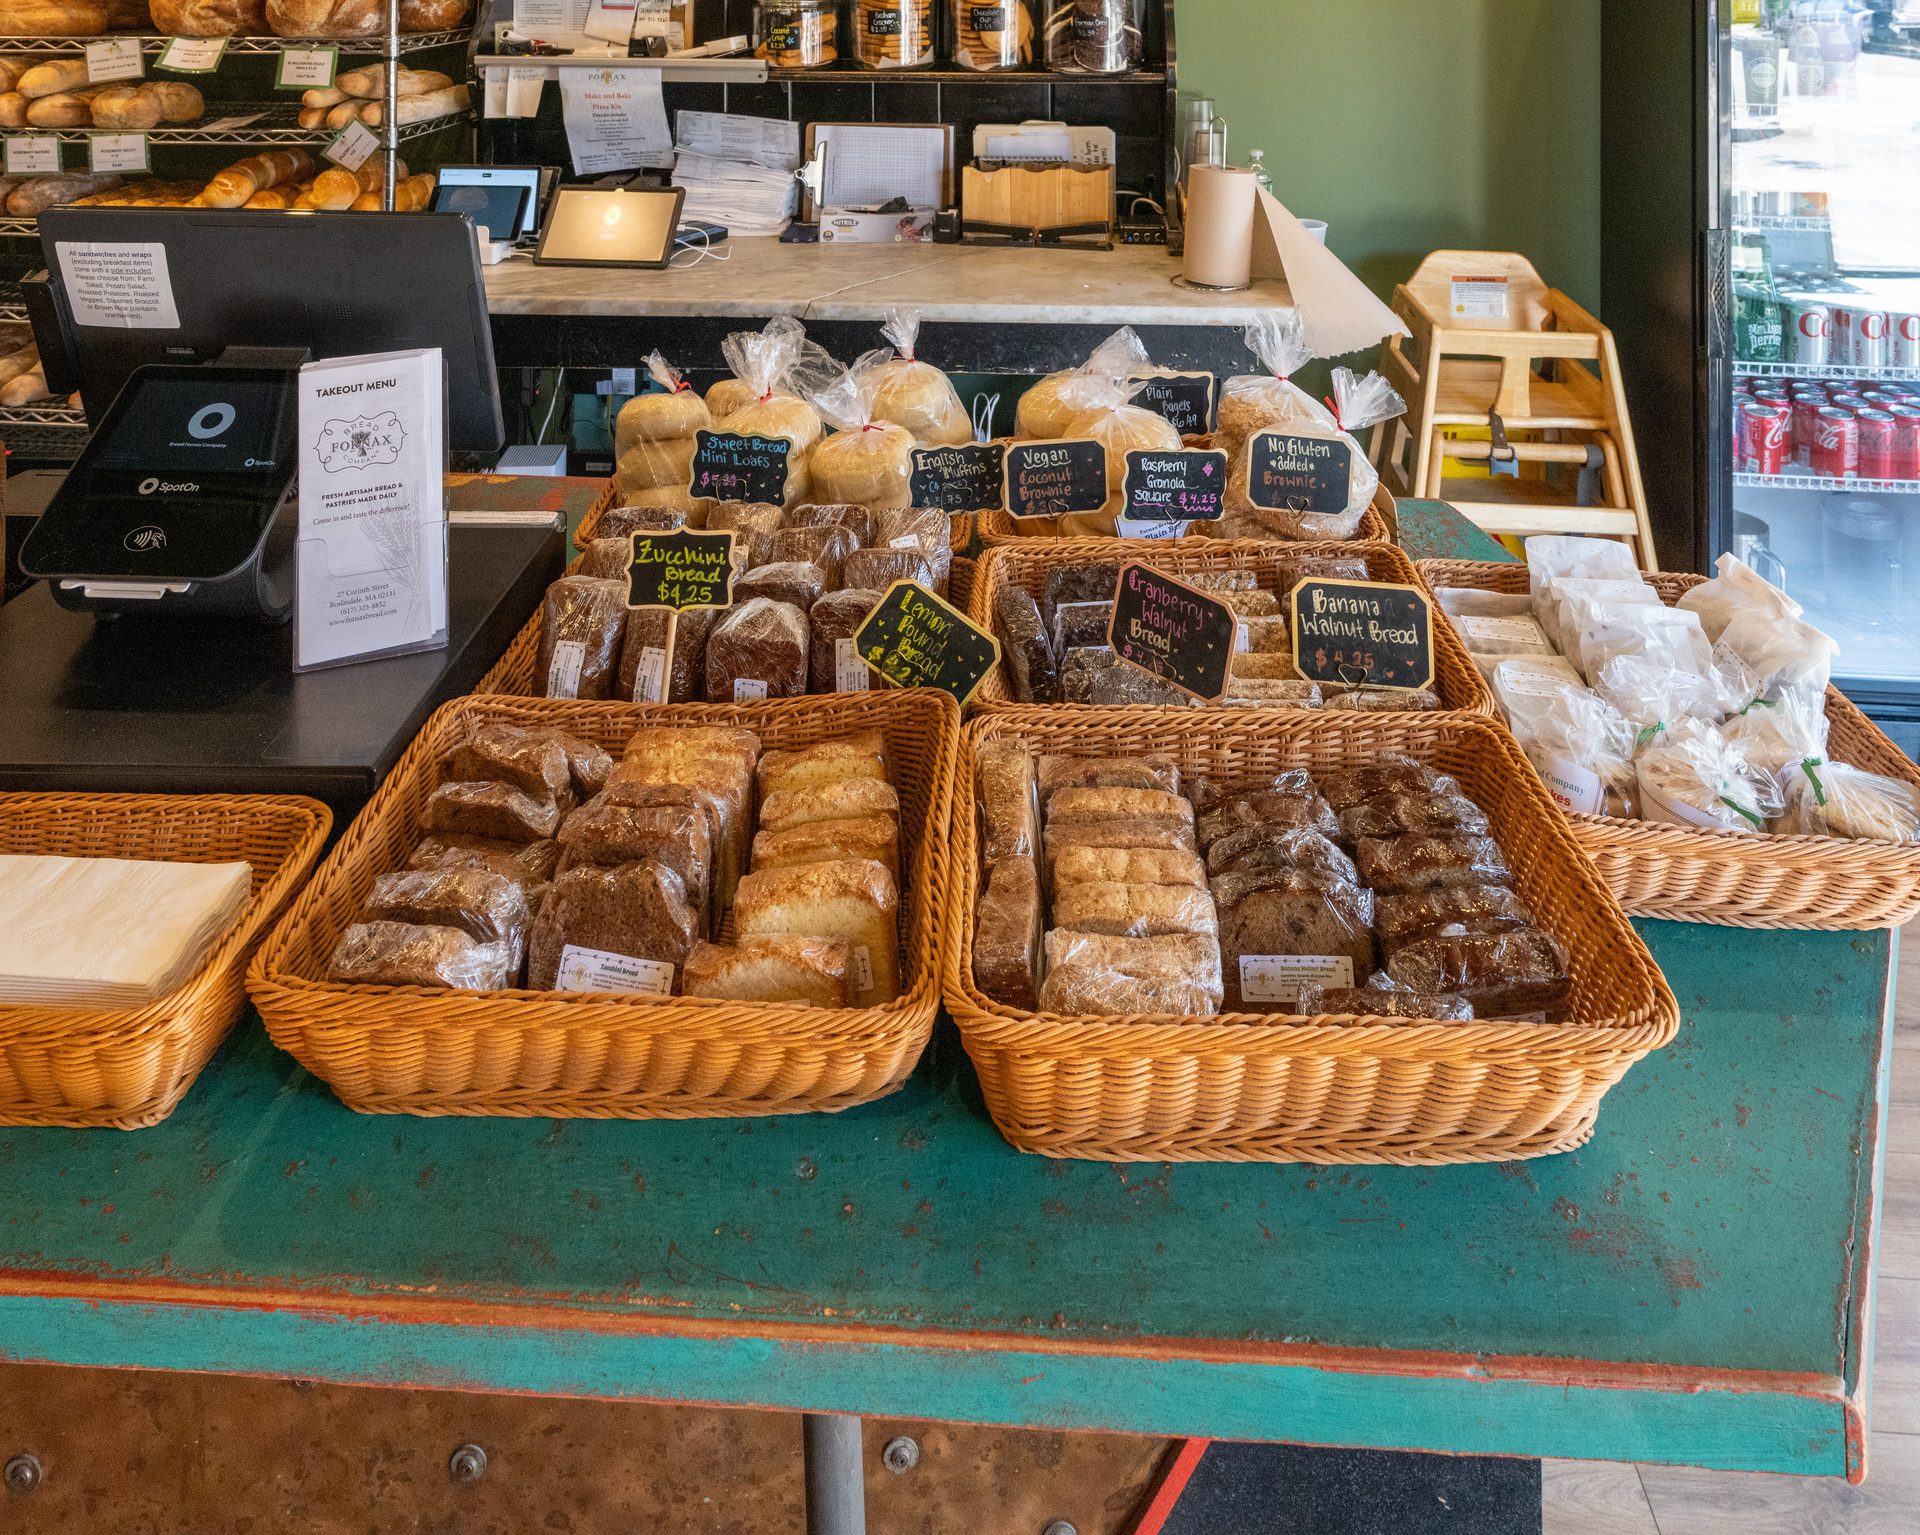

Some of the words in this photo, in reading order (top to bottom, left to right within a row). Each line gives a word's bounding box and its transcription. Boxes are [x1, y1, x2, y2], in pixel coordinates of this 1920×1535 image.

[1750, 335, 1782, 353] Perrie
[316, 383, 363, 398] TAKEOUT
[366, 379, 396, 390] MENU
[1146, 387, 1173, 400] Plain
[1162, 400, 1191, 418] Bagels
[344, 421, 378, 435] BREAD
[332, 434, 391, 453] FORNAX
[707, 437, 750, 451] Sweet
[752, 438, 787, 454] Bread
[1268, 437, 1285, 453] No
[1287, 438, 1330, 457] Gluten
[343, 450, 379, 464] COMPANY
[701, 449, 726, 463] Mini
[733, 453, 770, 468] Loafs
[916, 452, 965, 472] English
[1023, 449, 1069, 468] Vegan
[1277, 456, 1308, 471] added
[943, 462, 987, 479] Muffins
[1019, 466, 1072, 485] Coconut
[1140, 458, 1187, 476] Raspberry
[159, 482, 200, 493] SpotOn
[1147, 475, 1186, 489] Granola
[1264, 471, 1317, 489] Brownie
[322, 492, 343, 500] FRESH
[345, 487, 373, 497] ARTISAN
[375, 483, 397, 491] BREAD
[1020, 484, 1072, 501] Brownie
[326, 498, 356, 508] PASTRIES
[358, 495, 377, 503] MADE
[353, 511, 367, 519] taste
[380, 503, 410, 514] difference!
[1140, 526, 1158, 535] Fornax
[635, 539, 726, 566] Zucchini
[665, 566, 721, 583] Bread
[330, 597, 363, 608] Roslindale,
[378, 590, 396, 598] 02131
[346, 586, 370, 596] Corinth
[371, 584, 389, 592] Street
[657, 580, 712, 605] $4.25
[1129, 569, 1204, 630] Cranberry
[1312, 589, 1380, 616] Banana
[329, 608, 397, 626] www.fornaxbread.com
[341, 606, 356, 616] (617)
[900, 588, 954, 638] Lemon
[1142, 600, 1187, 641] Walnut
[898, 615, 948, 658] Pound
[1130, 618, 1171, 653] Bread
[1300, 613, 1364, 640] Walnut
[1368, 620, 1419, 647] Bread
[898, 637, 945, 680] Bread
[1546, 772, 1585, 796] Company
[568, 968, 592, 979] FOAX
[601, 964, 622, 973] Zucchini
[623, 968, 639, 976] Bread
